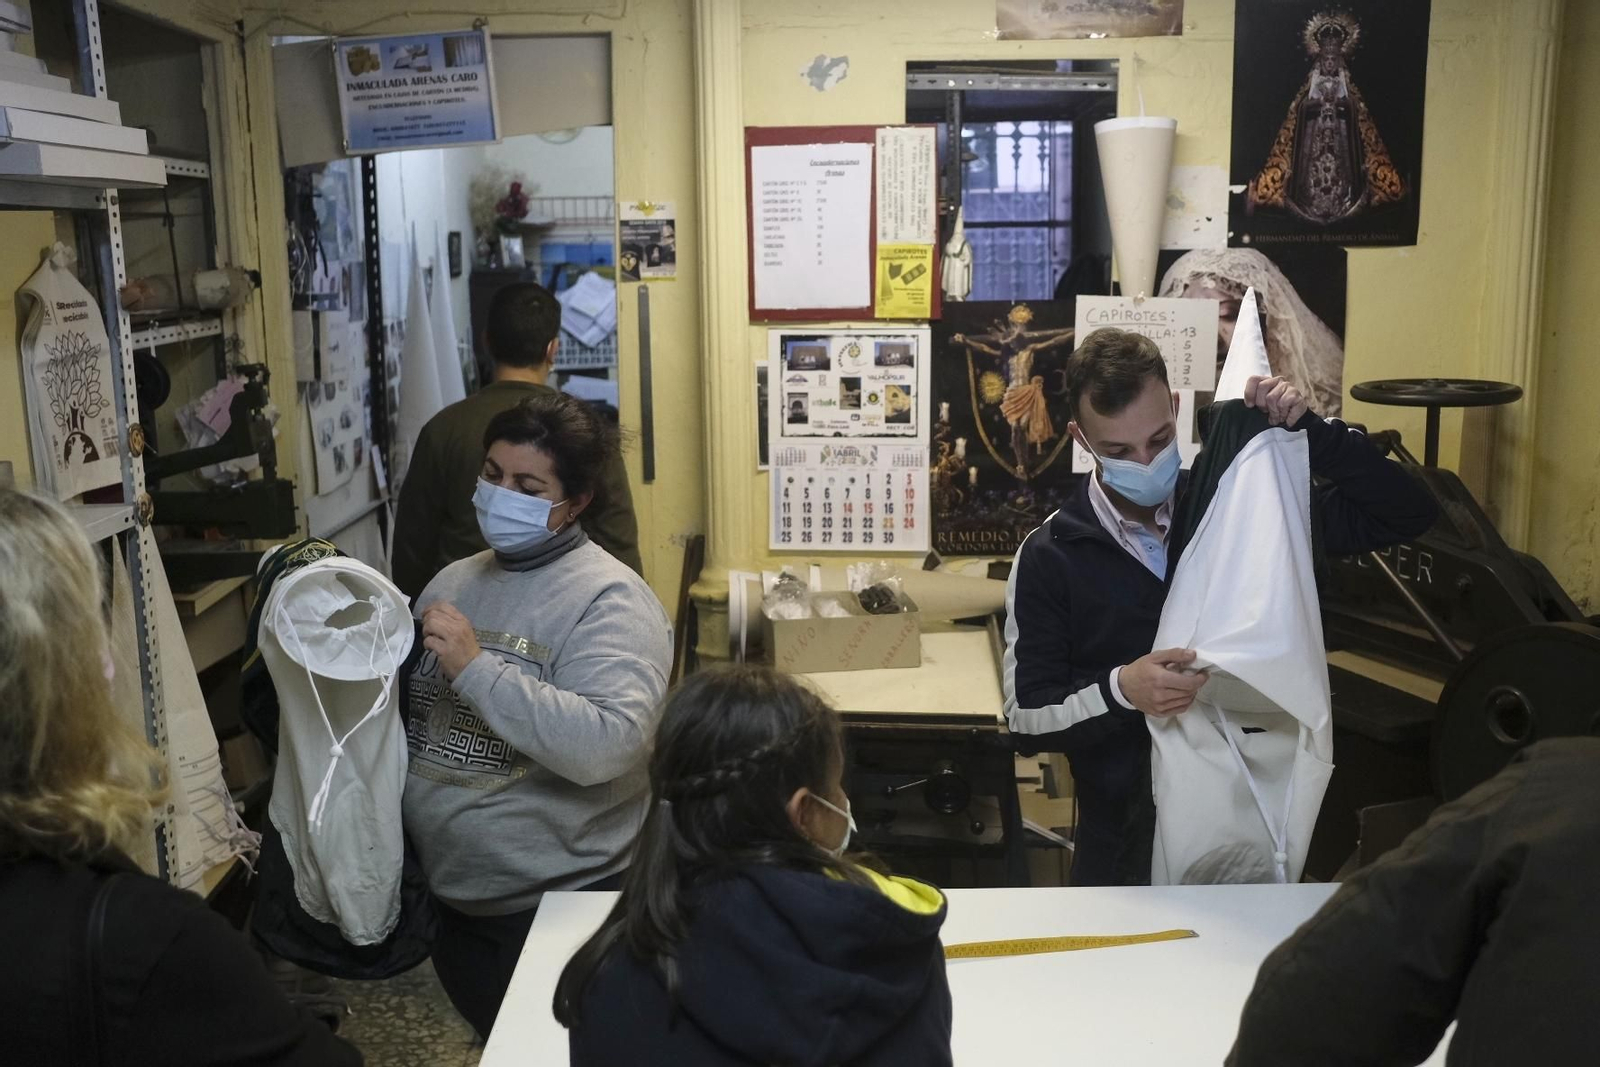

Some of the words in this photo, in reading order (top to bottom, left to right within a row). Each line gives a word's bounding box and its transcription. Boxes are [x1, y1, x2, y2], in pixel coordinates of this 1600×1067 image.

[346, 79, 408, 92] INMACULADA
[410, 75, 448, 86] ARENAS
[451, 72, 478, 82] CARO
[1181, 326, 1197, 338] 13
[1183, 341, 1192, 350] 5
[1185, 354, 1193, 362] 2
[1183, 366, 1191, 375] 3
[1184, 377, 1191, 385] 2
[1079, 450, 1088, 464] 6
[866, 473, 870, 484] 1
[886, 473, 891, 484] 2
[907, 473, 912, 484] 3
[783, 488, 789, 499] 4
[804, 488, 809, 499] 5
[824, 488, 830, 499] 6
[845, 488, 850, 499] 7
[865, 488, 871, 499] 8
[886, 488, 892, 499] 9
[905, 488, 915, 499] 10
[782, 503, 791, 514] 11
[802, 503, 812, 514] 12
[823, 503, 832, 514] 13
[843, 503, 853, 514] 14
[864, 503, 873, 514] 15
[884, 503, 894, 514] 16
[905, 503, 914, 514] 17
[782, 517, 792, 528] 18
[802, 517, 812, 528] 19
[822, 517, 833, 528] 20
[842, 517, 852, 528] 21
[862, 517, 873, 528] 22
[883, 517, 894, 528] 23
[903, 517, 915, 528] 24
[781, 532, 792, 543] 25
[801, 532, 812, 543] 26
[822, 532, 833, 543] 27
[842, 532, 853, 543] 28
[862, 532, 873, 543] 29
[883, 532, 894, 543] 30
[938, 531, 1009, 542] REMEDIO
[1017, 531, 1028, 542] D
